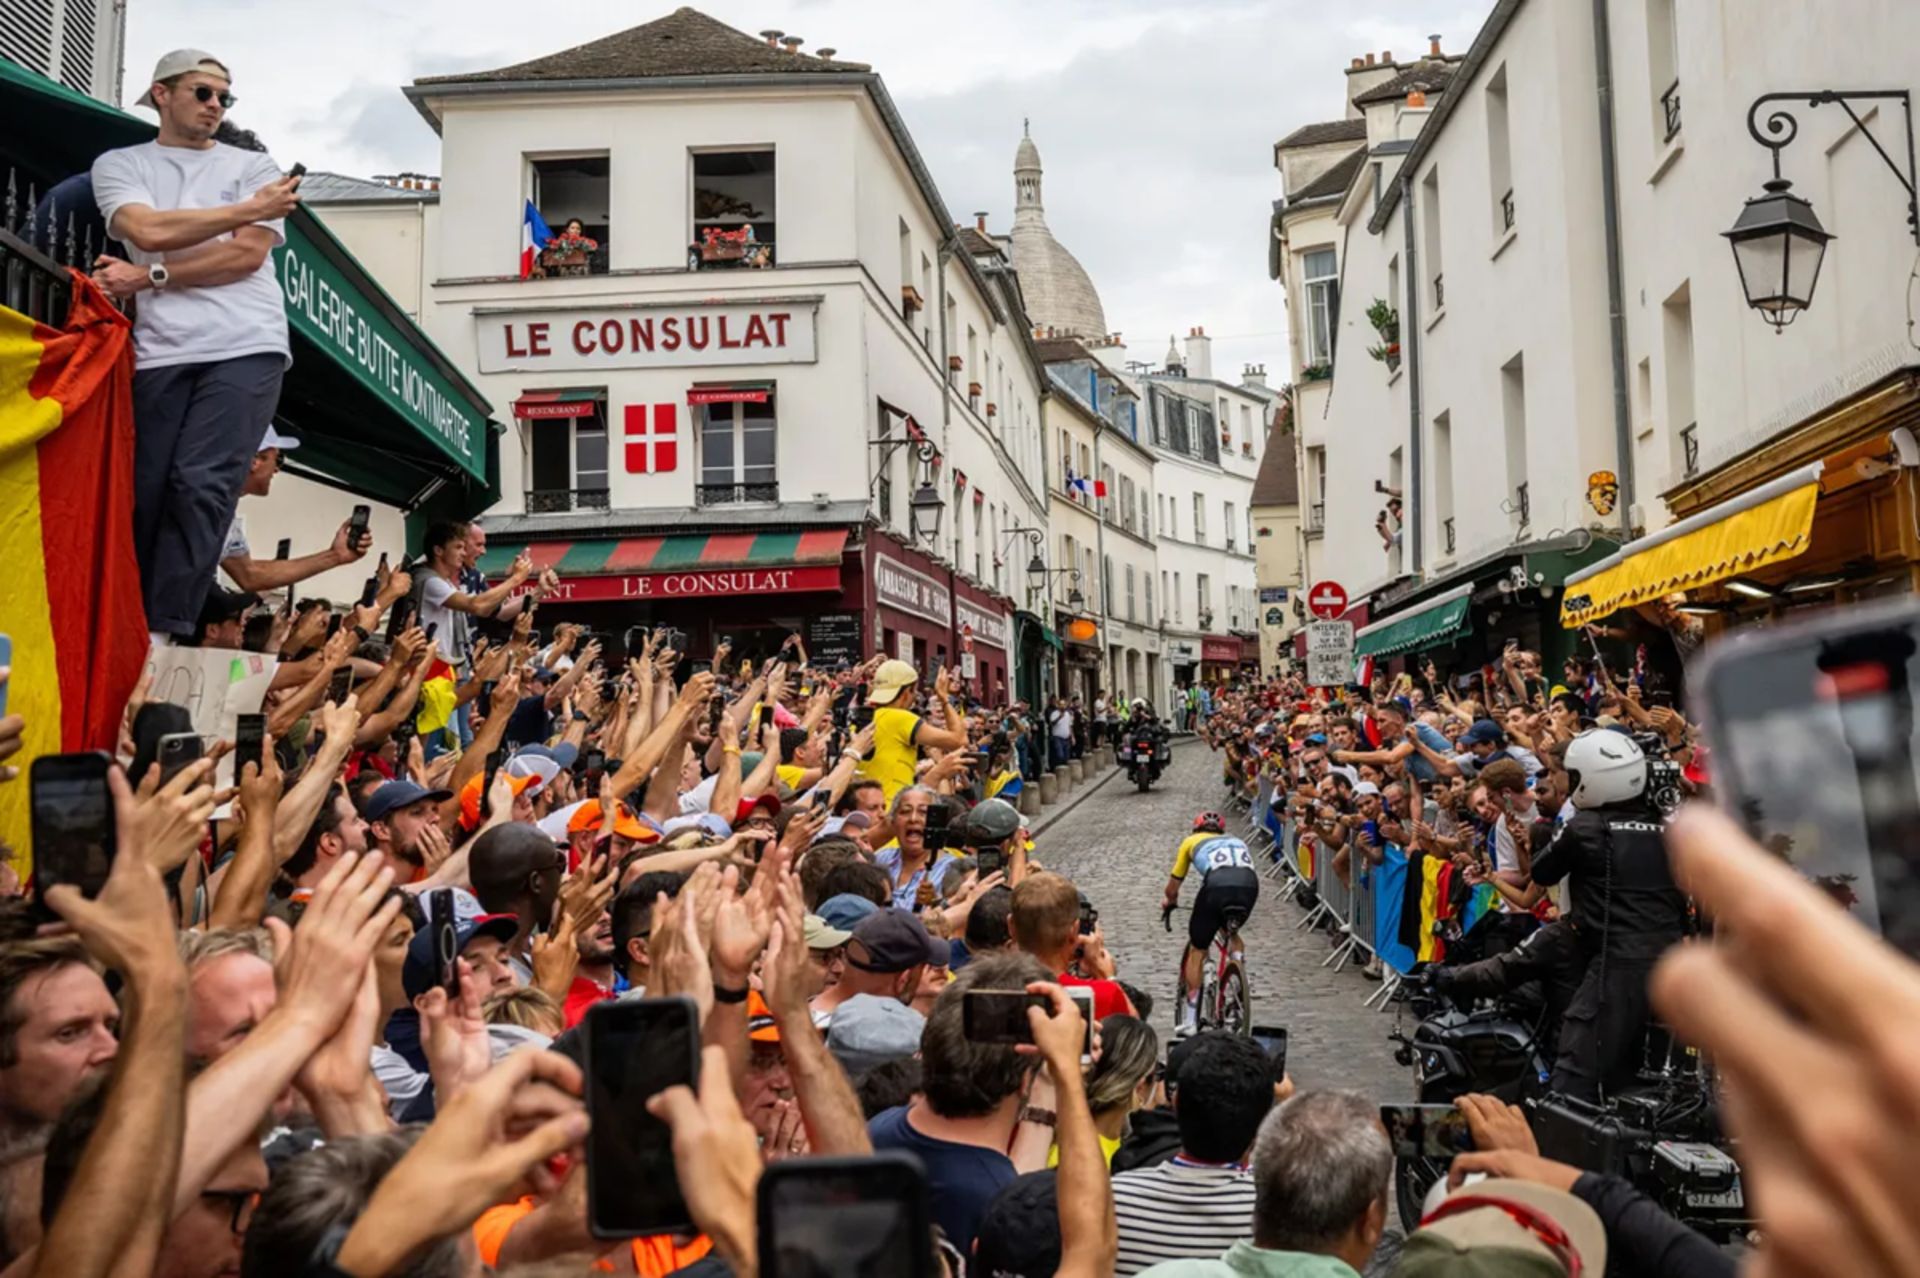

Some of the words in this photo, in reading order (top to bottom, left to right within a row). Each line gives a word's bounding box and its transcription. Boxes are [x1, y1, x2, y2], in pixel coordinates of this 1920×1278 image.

[504, 322, 552, 358] LE
[572, 313, 791, 355] CONSULAT
[284, 249, 355, 356] GALERIE
[358, 317, 400, 396] BUTTE
[402, 360, 472, 458] MONTMARTRE
[527, 405, 581, 415] RESTAURANT
[622, 577, 652, 596] LE
[663, 571, 793, 594] CONSULAT
[1318, 654, 1343, 663] SAUF
[1609, 820, 1666, 833] SCOTT
[1214, 850, 1228, 863] 6
